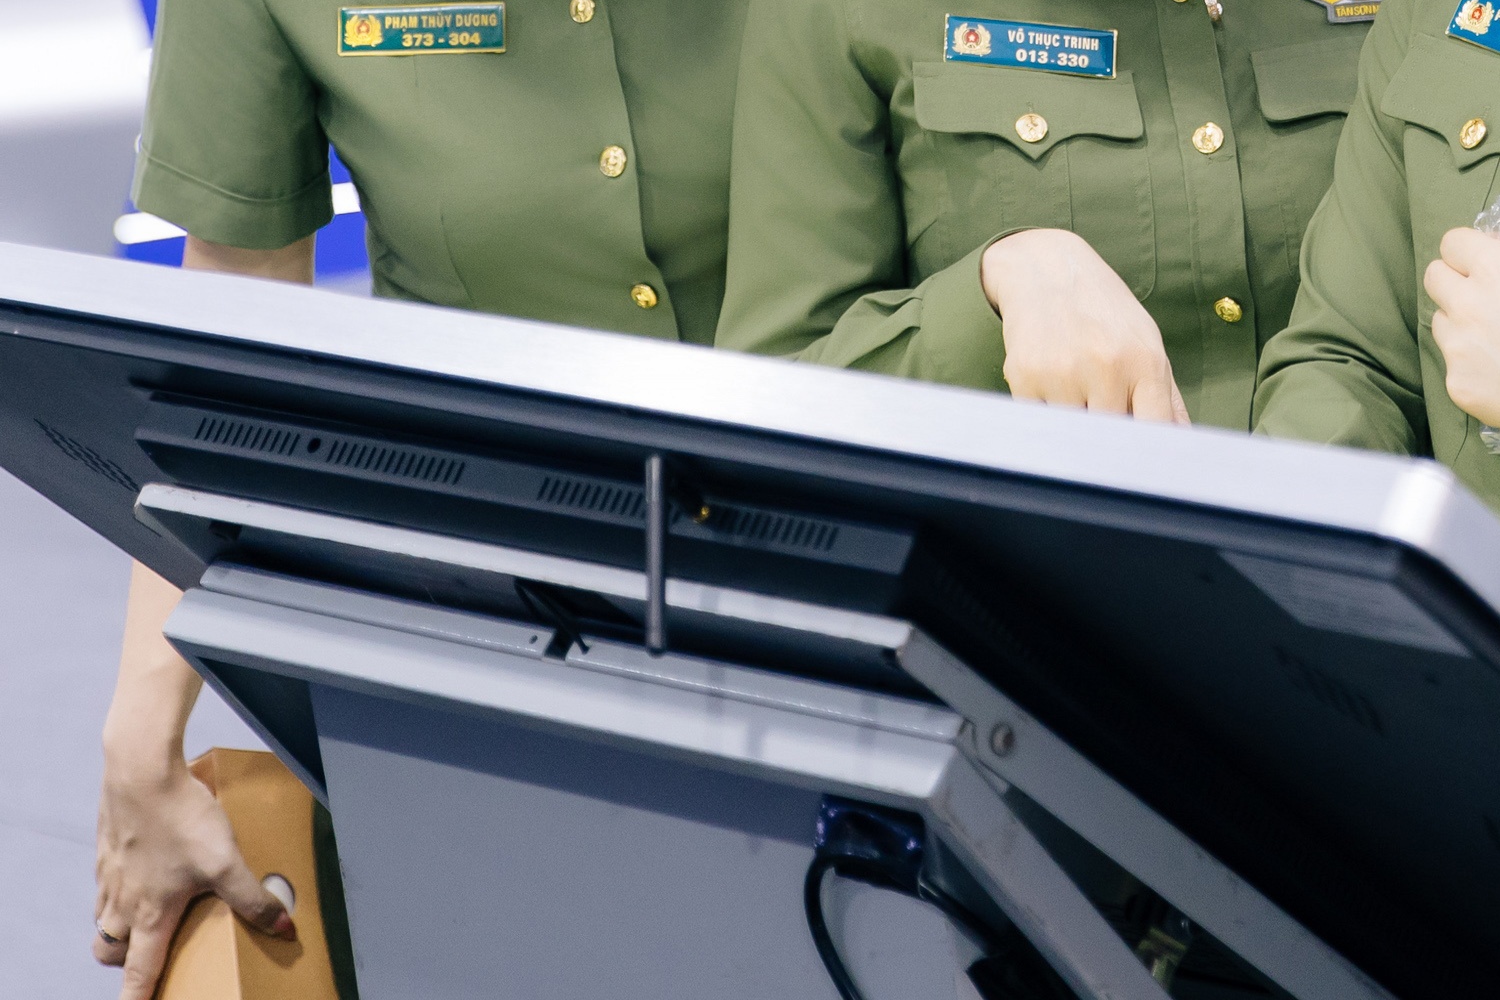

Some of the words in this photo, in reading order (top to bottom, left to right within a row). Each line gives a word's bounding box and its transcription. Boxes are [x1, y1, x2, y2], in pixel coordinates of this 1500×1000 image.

[385, 15, 418, 33] PHẠM
[455, 12, 498, 27] DƯƠNG
[402, 33, 434, 47] 373
[449, 32, 481, 46] 304
[1028, 31, 1060, 50] THỤC
[1063, 35, 1099, 51] TRINH
